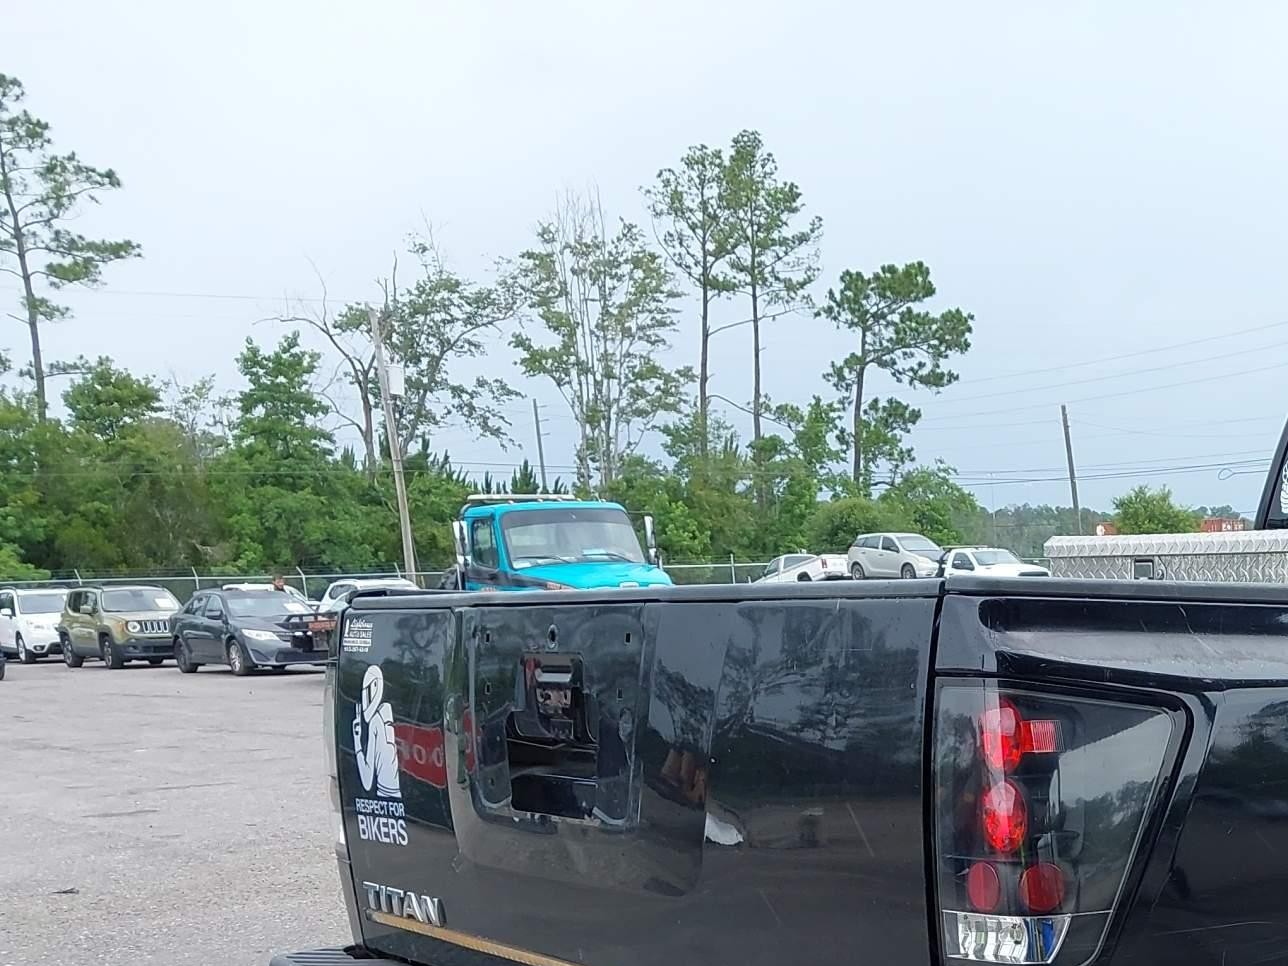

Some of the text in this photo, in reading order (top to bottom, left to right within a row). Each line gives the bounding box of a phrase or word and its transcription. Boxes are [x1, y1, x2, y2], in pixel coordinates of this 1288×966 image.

[355, 798, 405, 817] RESPECT FOR
[358, 814, 409, 846] BIKERS
[362, 881, 445, 927] TITAN
